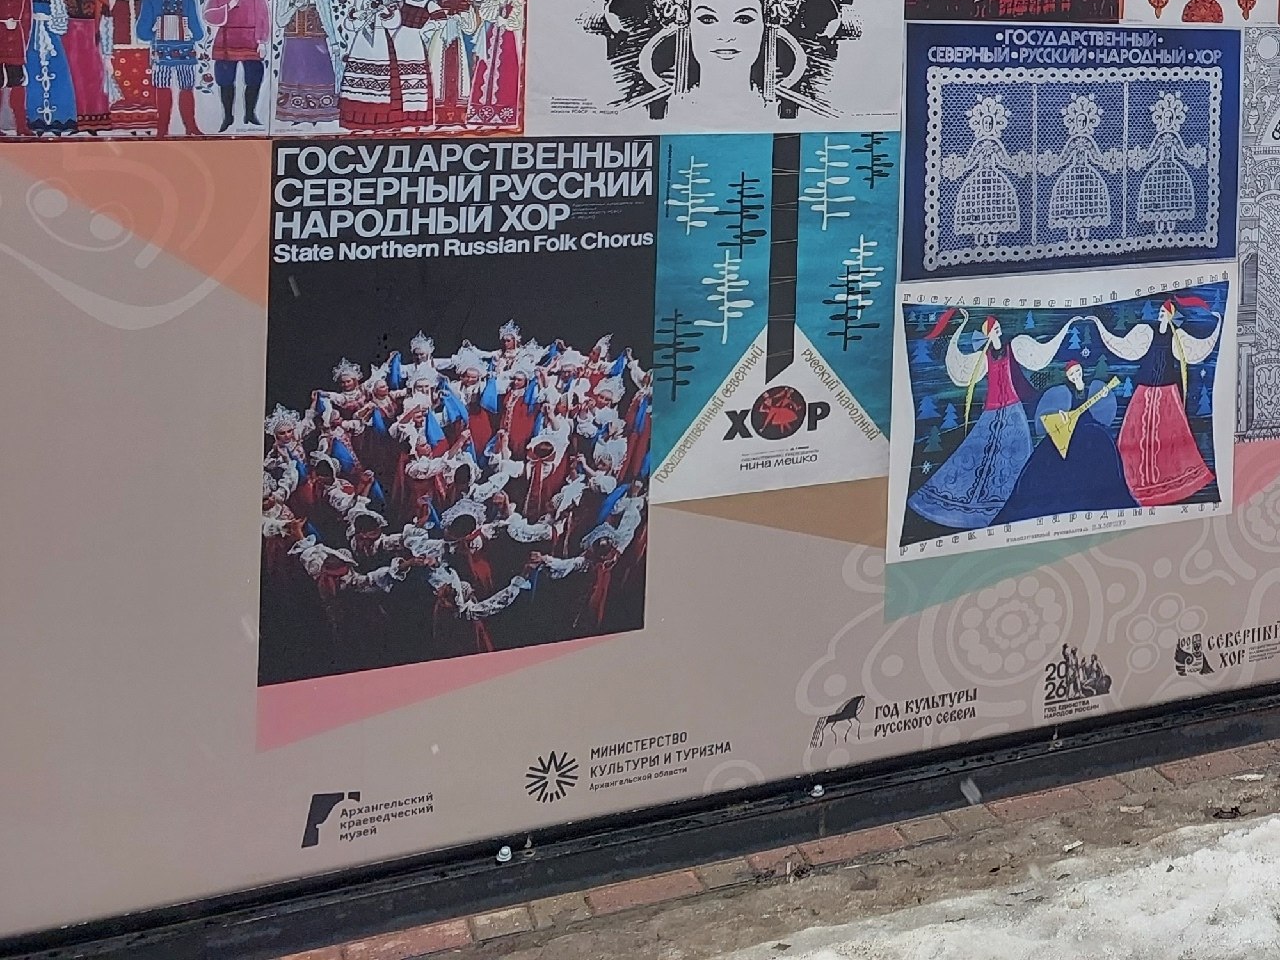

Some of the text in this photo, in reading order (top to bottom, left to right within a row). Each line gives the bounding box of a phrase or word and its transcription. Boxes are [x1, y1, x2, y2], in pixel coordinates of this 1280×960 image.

[1004, 28, 1156, 47] ГОСУДАРСТВЕННЫЙ
[928, 44, 1222, 65] СЕВЕРНЫЙ РУССКИЙ НАРОДНЫЙ ХОР
[275, 139, 653, 176] ГОСУДАРСТВЕННЫЙ
[274, 172, 482, 208] СЕВЕРНЫЙ
[489, 169, 653, 204] РУССКИЙ
[274, 203, 491, 240] НАРОДНЫЙ
[499, 203, 570, 233] ХОР
[273, 231, 654, 263] State Northern Russian Folk Chorus
[723, 386, 830, 441] ХОР
[1045, 661, 1067, 682] 20
[1219, 649, 1245, 668] ХОР
[875, 687, 978, 719] ГОД КУЛЬТУРЫ
[1044, 680, 1067, 700] 26
[874, 706, 976, 738] РУССКОГО СЕВЕРА
[590, 732, 688, 761] МИНИСТЕРСТВО
[590, 741, 732, 779] КУЛЬТУРЫ И ТУРИЗМА
[589, 766, 688, 792] Архангельской области
[340, 792, 435, 819] Архангельский
[340, 803, 435, 830] краеведческий
[339, 825, 378, 842] музей
